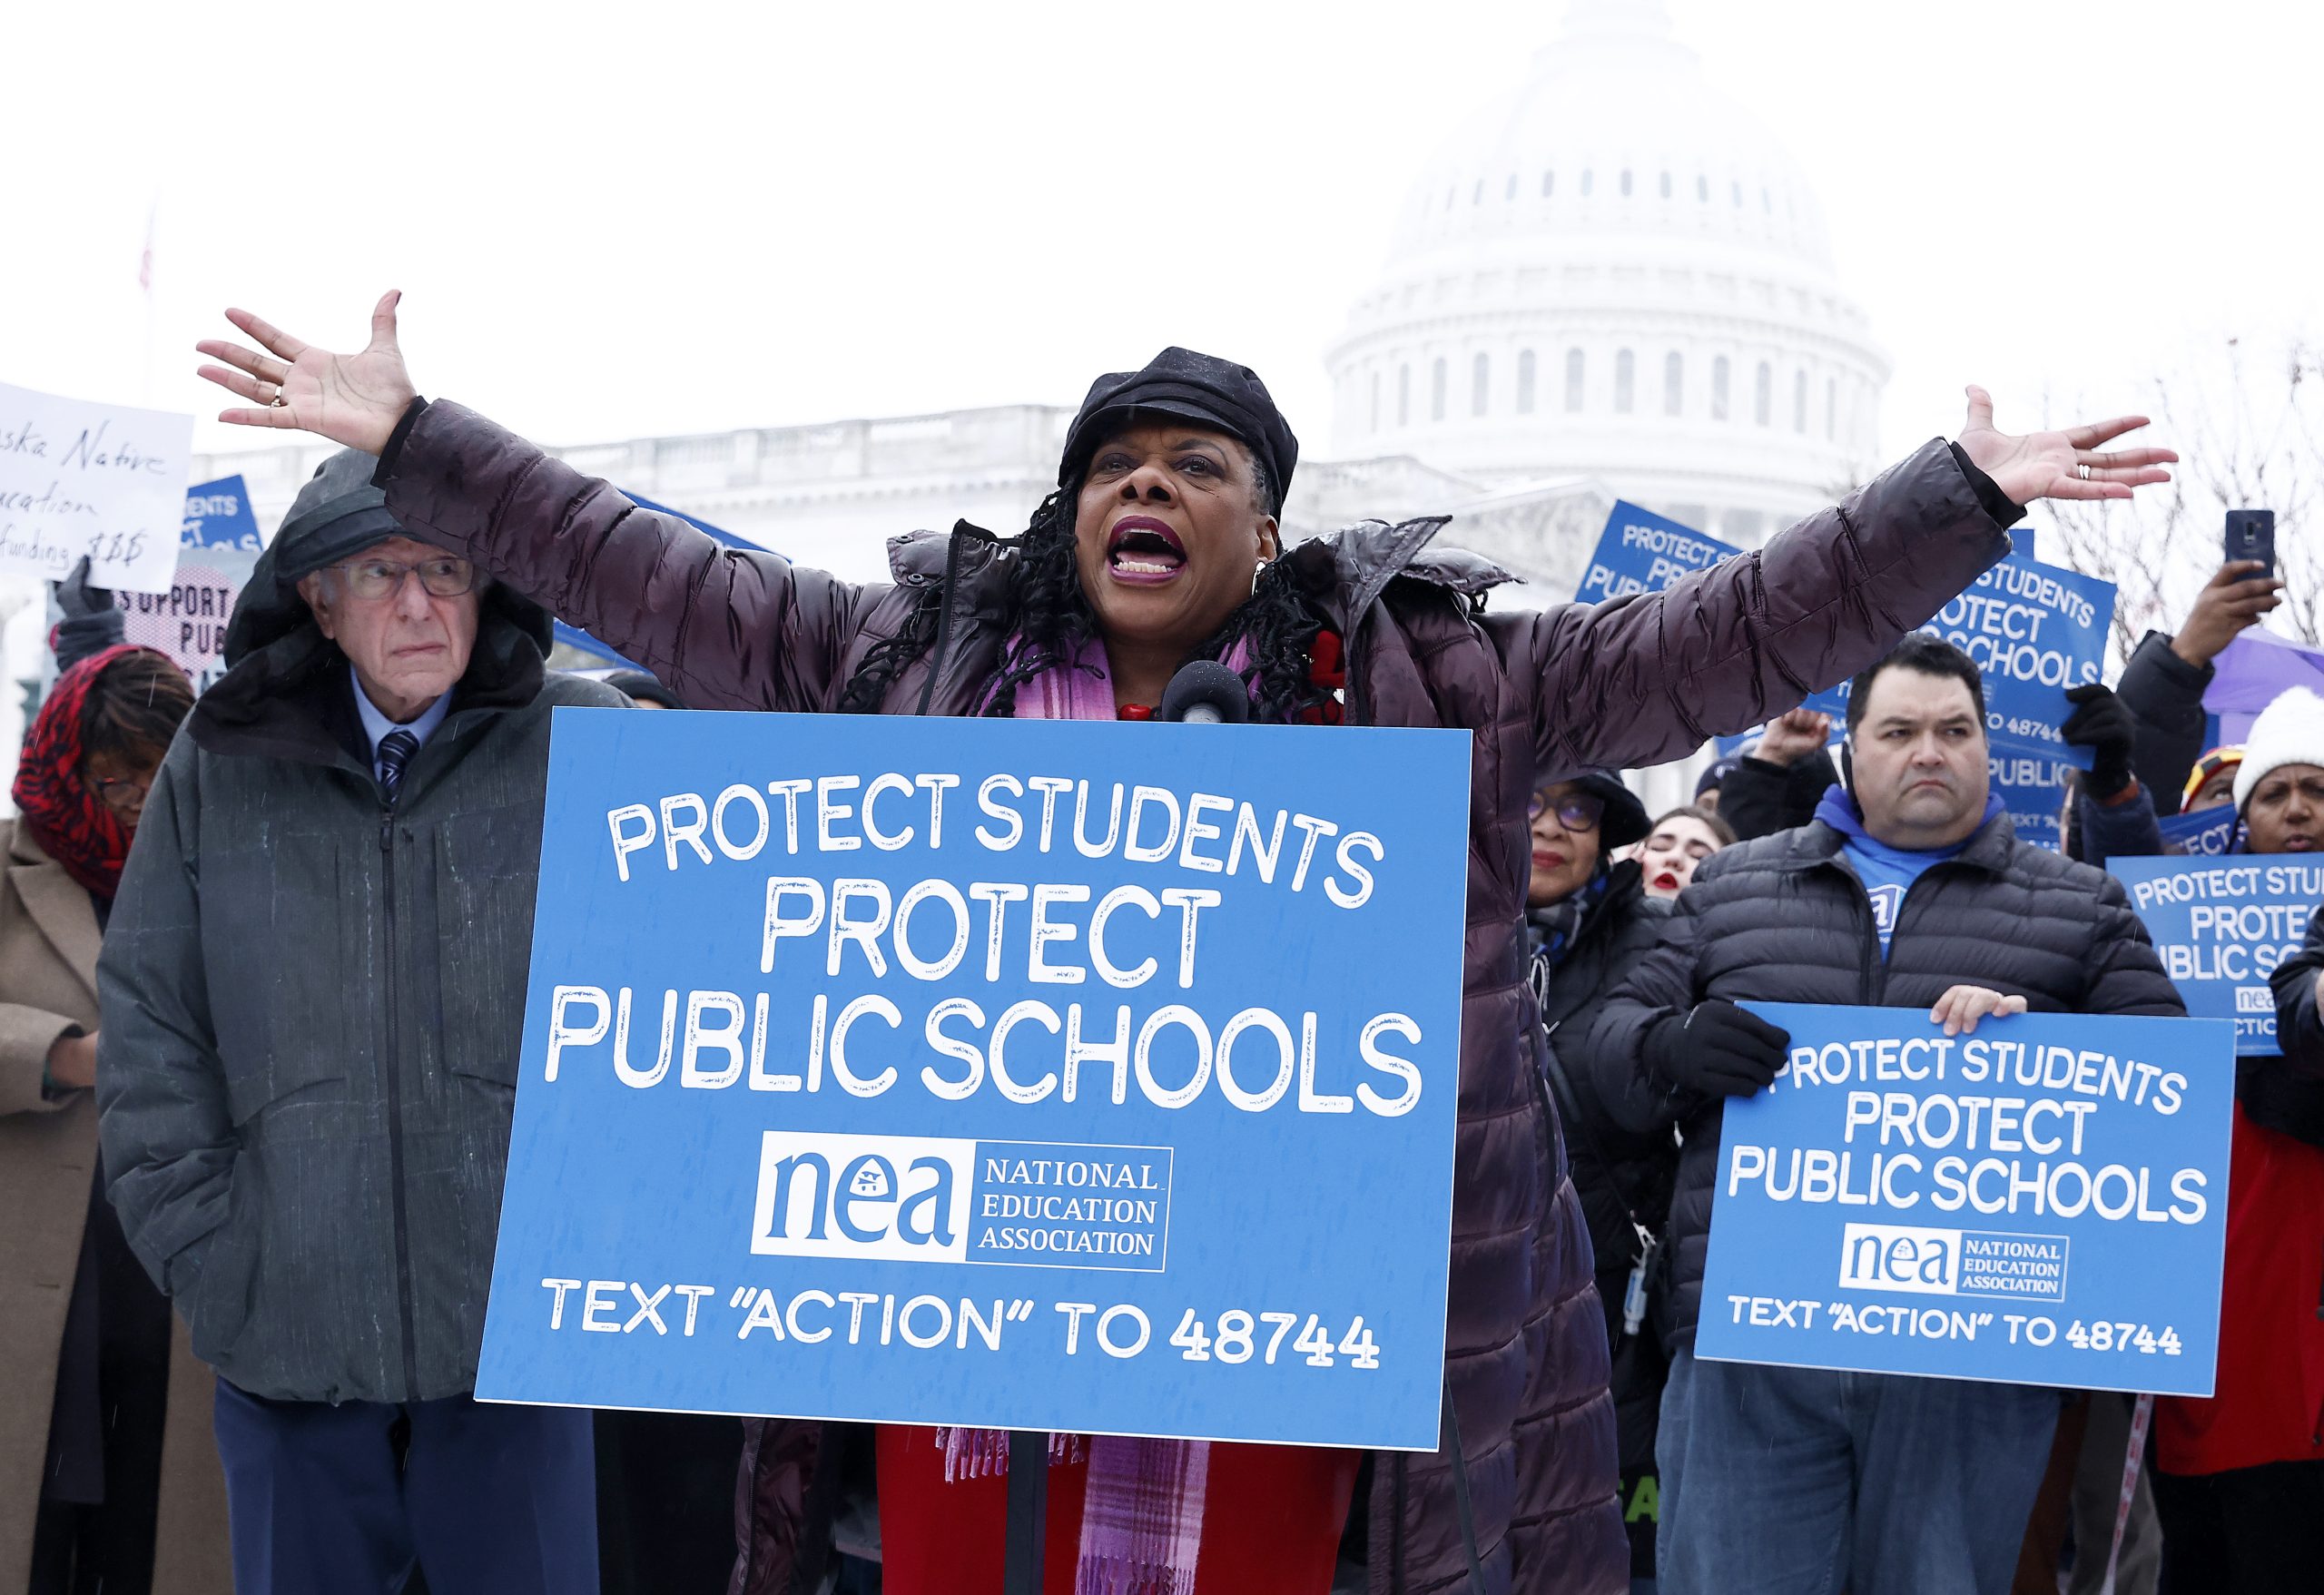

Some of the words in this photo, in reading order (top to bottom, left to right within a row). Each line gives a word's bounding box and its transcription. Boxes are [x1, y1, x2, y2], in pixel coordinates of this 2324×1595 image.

[0, 420, 47, 458] ska
[60, 419, 167, 476] Native
[1621, 524, 1718, 568] PROTECT
[1931, 594, 2049, 644] OTECT
[607, 773, 960, 882] PROTECT
[974, 773, 1384, 910] STUDENTS
[2133, 867, 2261, 911] PROTECT
[2265, 865, 2324, 896] STU
[760, 876, 1222, 989] PROTECT
[2190, 904, 2322, 942] PROTE
[544, 984, 903, 1098] PUBLIC
[921, 997, 1423, 1117] SCHOOLS
[1960, 1039, 2188, 1116] STUDENTS
[1844, 1090, 2098, 1156] PROTECT
[764, 1150, 957, 1247] nea
[984, 1157, 1158, 1190] NATIONAL
[1728, 1145, 1923, 1209] PUBLIC
[1930, 1156, 2208, 1225] SCHOOLS
[981, 1193, 1158, 1225] EDUCATION
[978, 1226, 1156, 1255] ASSOCIATION
[1848, 1235, 1949, 1285] nea
[1965, 1239, 2062, 1260] NATIONAL
[1962, 1275, 2058, 1294] ASSOCIATION
[1963, 1257, 2061, 1277] EDUCATION
[541, 1277, 715, 1337] TEXT
[729, 1285, 1035, 1352] "ACTION"
[1054, 1302, 1151, 1359] TO
[1168, 1307, 1381, 1370] 48744
[1728, 1295, 1822, 1329] TEXT
[1827, 1302, 1994, 1342] "ACTION"
[2003, 1314, 2057, 1347] TO
[2064, 1320, 2182, 1356] 48744
